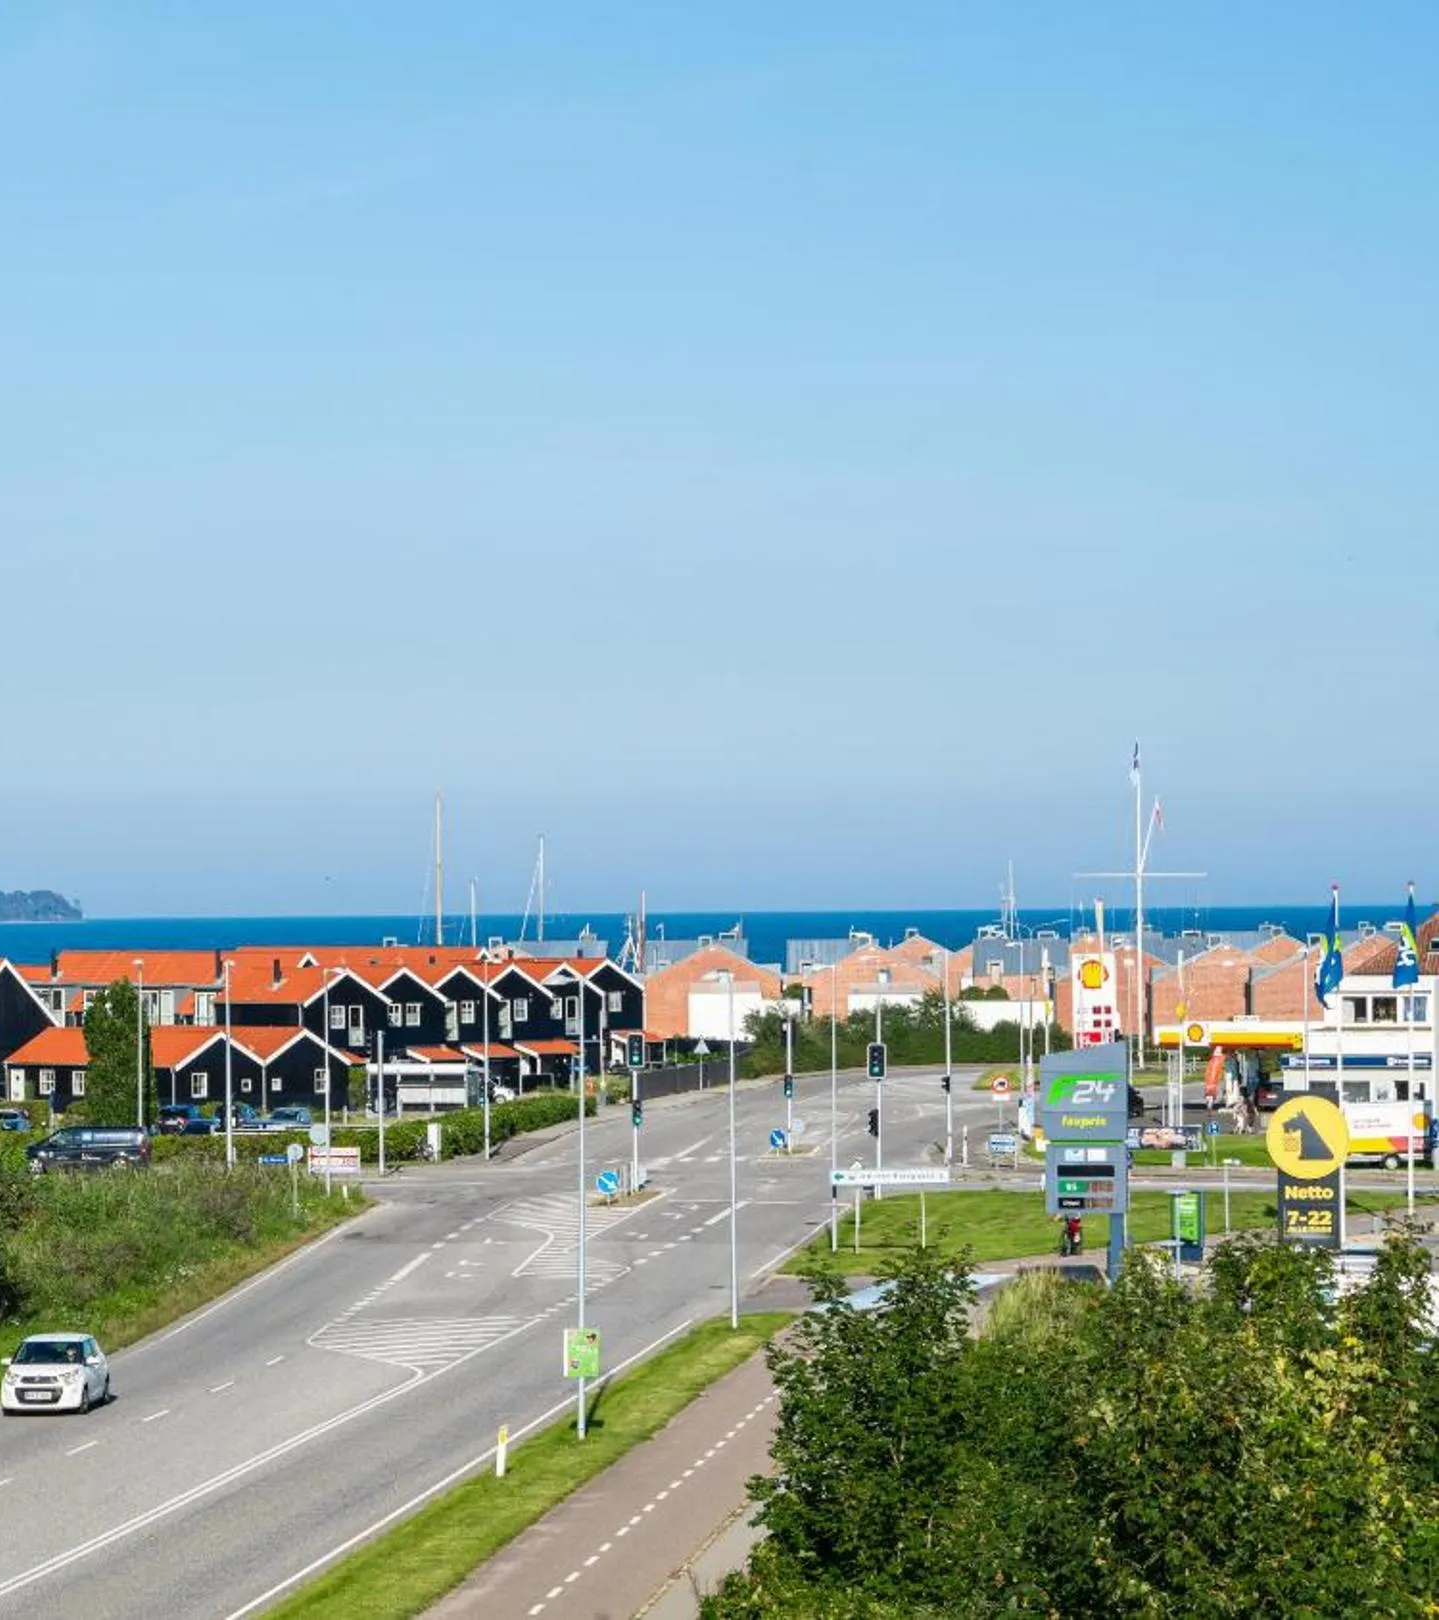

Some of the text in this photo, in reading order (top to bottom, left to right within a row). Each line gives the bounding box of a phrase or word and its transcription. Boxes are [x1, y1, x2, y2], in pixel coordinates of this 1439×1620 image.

[1047, 1073, 1121, 1105] F24
[1284, 1186, 1334, 1200] Netto
[1286, 1210, 1333, 1225] 7-22
